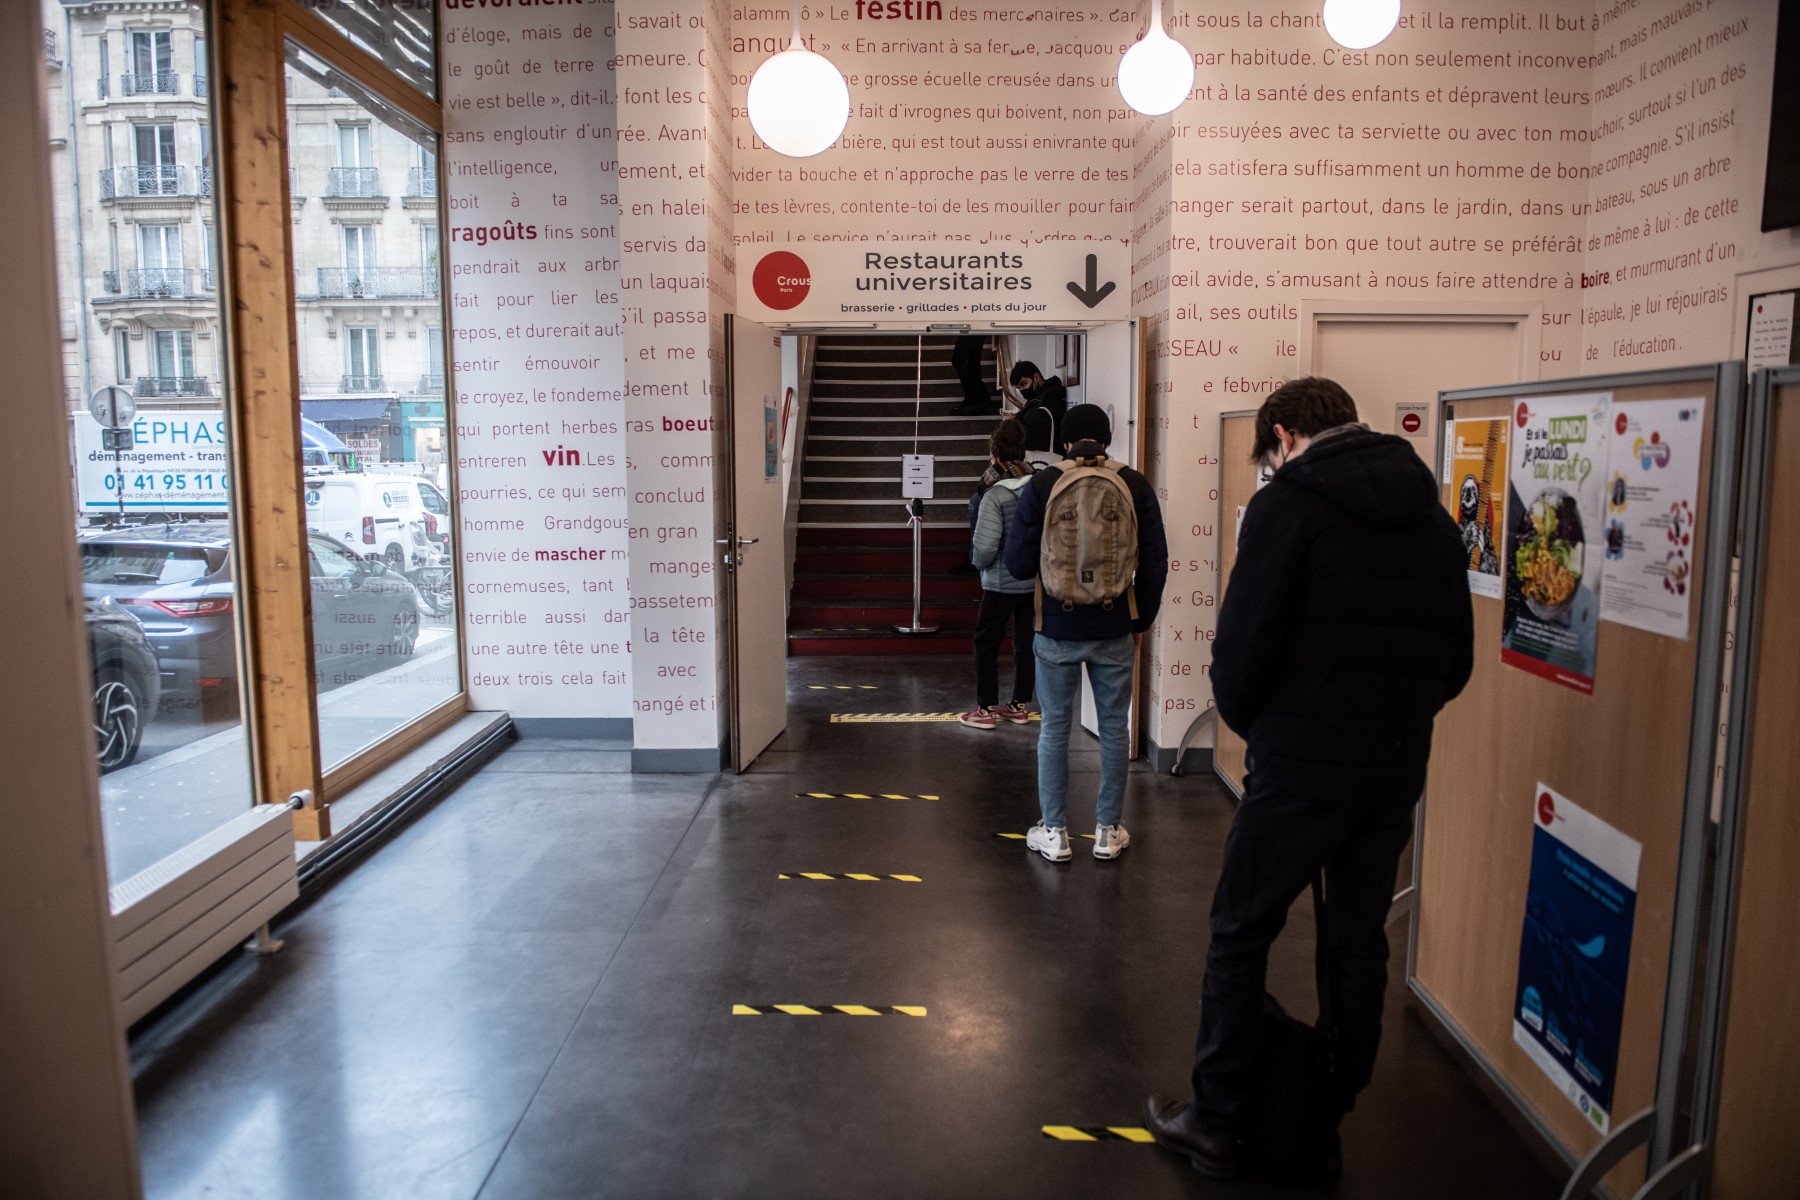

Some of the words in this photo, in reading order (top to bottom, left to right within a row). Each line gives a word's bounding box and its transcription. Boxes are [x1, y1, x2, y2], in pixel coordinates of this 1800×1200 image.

[856, 0, 942, 20] festin
[629, 12, 681, 28] savait
[1197, 16, 1239, 27] sous
[1462, 13, 1531, 34] remplit.
[447, 27, 510, 46] d'éloge,
[523, 24, 561, 40] mais
[1232, 49, 1315, 65] habitude.
[1323, 49, 1368, 65] C'est
[1415, 50, 1511, 67] seulement
[1620, 26, 1647, 53] mais
[1651, 0, 1703, 36] mauvais
[882, 39, 944, 54] arrivant
[474, 59, 510, 80] goût
[554, 59, 593, 72] terre
[1257, 84, 1307, 101] santé
[1352, 85, 1419, 102] enfants
[1449, 86, 1538, 108] dépravent
[1545, 88, 1589, 105] leurs
[1595, 75, 1635, 103] mœurs.
[1650, 37, 1702, 76] convient
[1706, 18, 1748, 50] mieux
[865, 75, 917, 89] grosse
[924, 71, 981, 86] écuelle
[988, 72, 1050, 86] creusée
[1057, 73, 1094, 87] dans
[507, 92, 545, 107] belle
[571, 90, 613, 105] dit-il.
[625, 88, 659, 104] font
[860, 104, 883, 118] fait
[889, 104, 971, 122] d'ivrognes
[1006, 105, 1066, 121] boivent,
[1198, 121, 1281, 142] essuyées
[1290, 127, 1329, 138] avec
[1362, 123, 1440, 139] serviette
[1477, 129, 1516, 140] avec
[1629, 93, 1671, 125] surtout
[447, 131, 484, 143] sans
[494, 125, 567, 145] engloutir
[843, 134, 885, 150] bière,
[950, 136, 980, 148] tout
[986, 135, 1027, 148] aussi
[1033, 134, 1106, 148] enivrante
[1209, 159, 1287, 175] satisfera
[1295, 160, 1420, 176] suffisamment
[1456, 161, 1524, 178] homme
[1606, 136, 1671, 172] compagnie.
[1699, 108, 1735, 137] insist
[449, 160, 556, 178] l'intelligence,
[732, 168, 772, 182] vider
[800, 167, 856, 181] bouche
[886, 167, 973, 184] n'approche
[1035, 171, 1074, 180] verre
[1242, 197, 1293, 213] serait
[1303, 199, 1372, 217] partout,
[1382, 197, 1425, 214] dans
[1456, 198, 1511, 219] jardin,
[1521, 199, 1563, 215] dans
[1640, 179, 1667, 198] sous
[1694, 158, 1730, 181] arbre
[451, 194, 479, 209] boit
[785, 198, 834, 215] lèvres,
[841, 200, 936, 213] contente-toi
[995, 199, 1061, 213] mouiller
[1069, 203, 1105, 217] pour
[452, 220, 537, 246] ragoûts
[545, 225, 573, 239] fins
[581, 225, 615, 238] sont
[1209, 234, 1296, 250] trouverait
[1387, 236, 1421, 250] tout
[1430, 236, 1476, 251] autre
[1513, 235, 1582, 256] préférât
[1604, 226, 1639, 247] même
[1705, 198, 1738, 220] cette
[624, 236, 677, 252] servis
[454, 259, 519, 279] pendrait
[866, 252, 1022, 269] Restaurants
[1207, 270, 1258, 288] avide,
[1266, 271, 1361, 287] s'amusant
[1386, 276, 1428, 287] nous
[1436, 272, 1475, 288] faire
[1483, 273, 1557, 288] attendre
[1582, 270, 1612, 289] boire,
[1631, 248, 1701, 278] murmurant
[777, 276, 811, 286] Crous
[857, 272, 1031, 290] universitaires
[454, 293, 479, 307] fait
[498, 295, 534, 310] pour
[552, 291, 577, 305] lier
[841, 304, 894, 312] brasserie
[907, 303, 959, 314] grillades
[972, 303, 1001, 313] plats
[1005, 303, 1020, 311] du
[1022, 303, 1047, 313] jour
[1581, 304, 1625, 327] l'épaule,
[1667, 283, 1727, 314] réjouirais
[1248, 304, 1297, 319] outils
[453, 329, 500, 344] repos,
[526, 322, 589, 338] durerait
[1614, 335, 1675, 357] l'éducation
[454, 357, 500, 371] sentir
[526, 355, 600, 370] émouvoir
[474, 393, 527, 407] croyez,
[493, 422, 550, 439] portent
[562, 420, 617, 434] herbes
[1550, 420, 1586, 440] LUNDI
[348, 440, 378, 448] SOLDES
[105, 474, 125, 490] 01
[134, 475, 154, 490] 41
[163, 474, 186, 490] 95
[194, 474, 212, 489] 11
[461, 485, 531, 503] pourries,
[465, 517, 524, 530] homme
[466, 548, 506, 562] envie
[535, 547, 606, 561] mascher
[468, 582, 569, 594] cornemuses,
[470, 610, 526, 624] terrible
[545, 609, 585, 623] aussi
[672, 627, 705, 642] tête
[507, 643, 547, 654] autre
[554, 640, 583, 654] tête
[474, 672, 509, 685] deux
[518, 673, 552, 685] trois
[562, 671, 592, 685] cela
